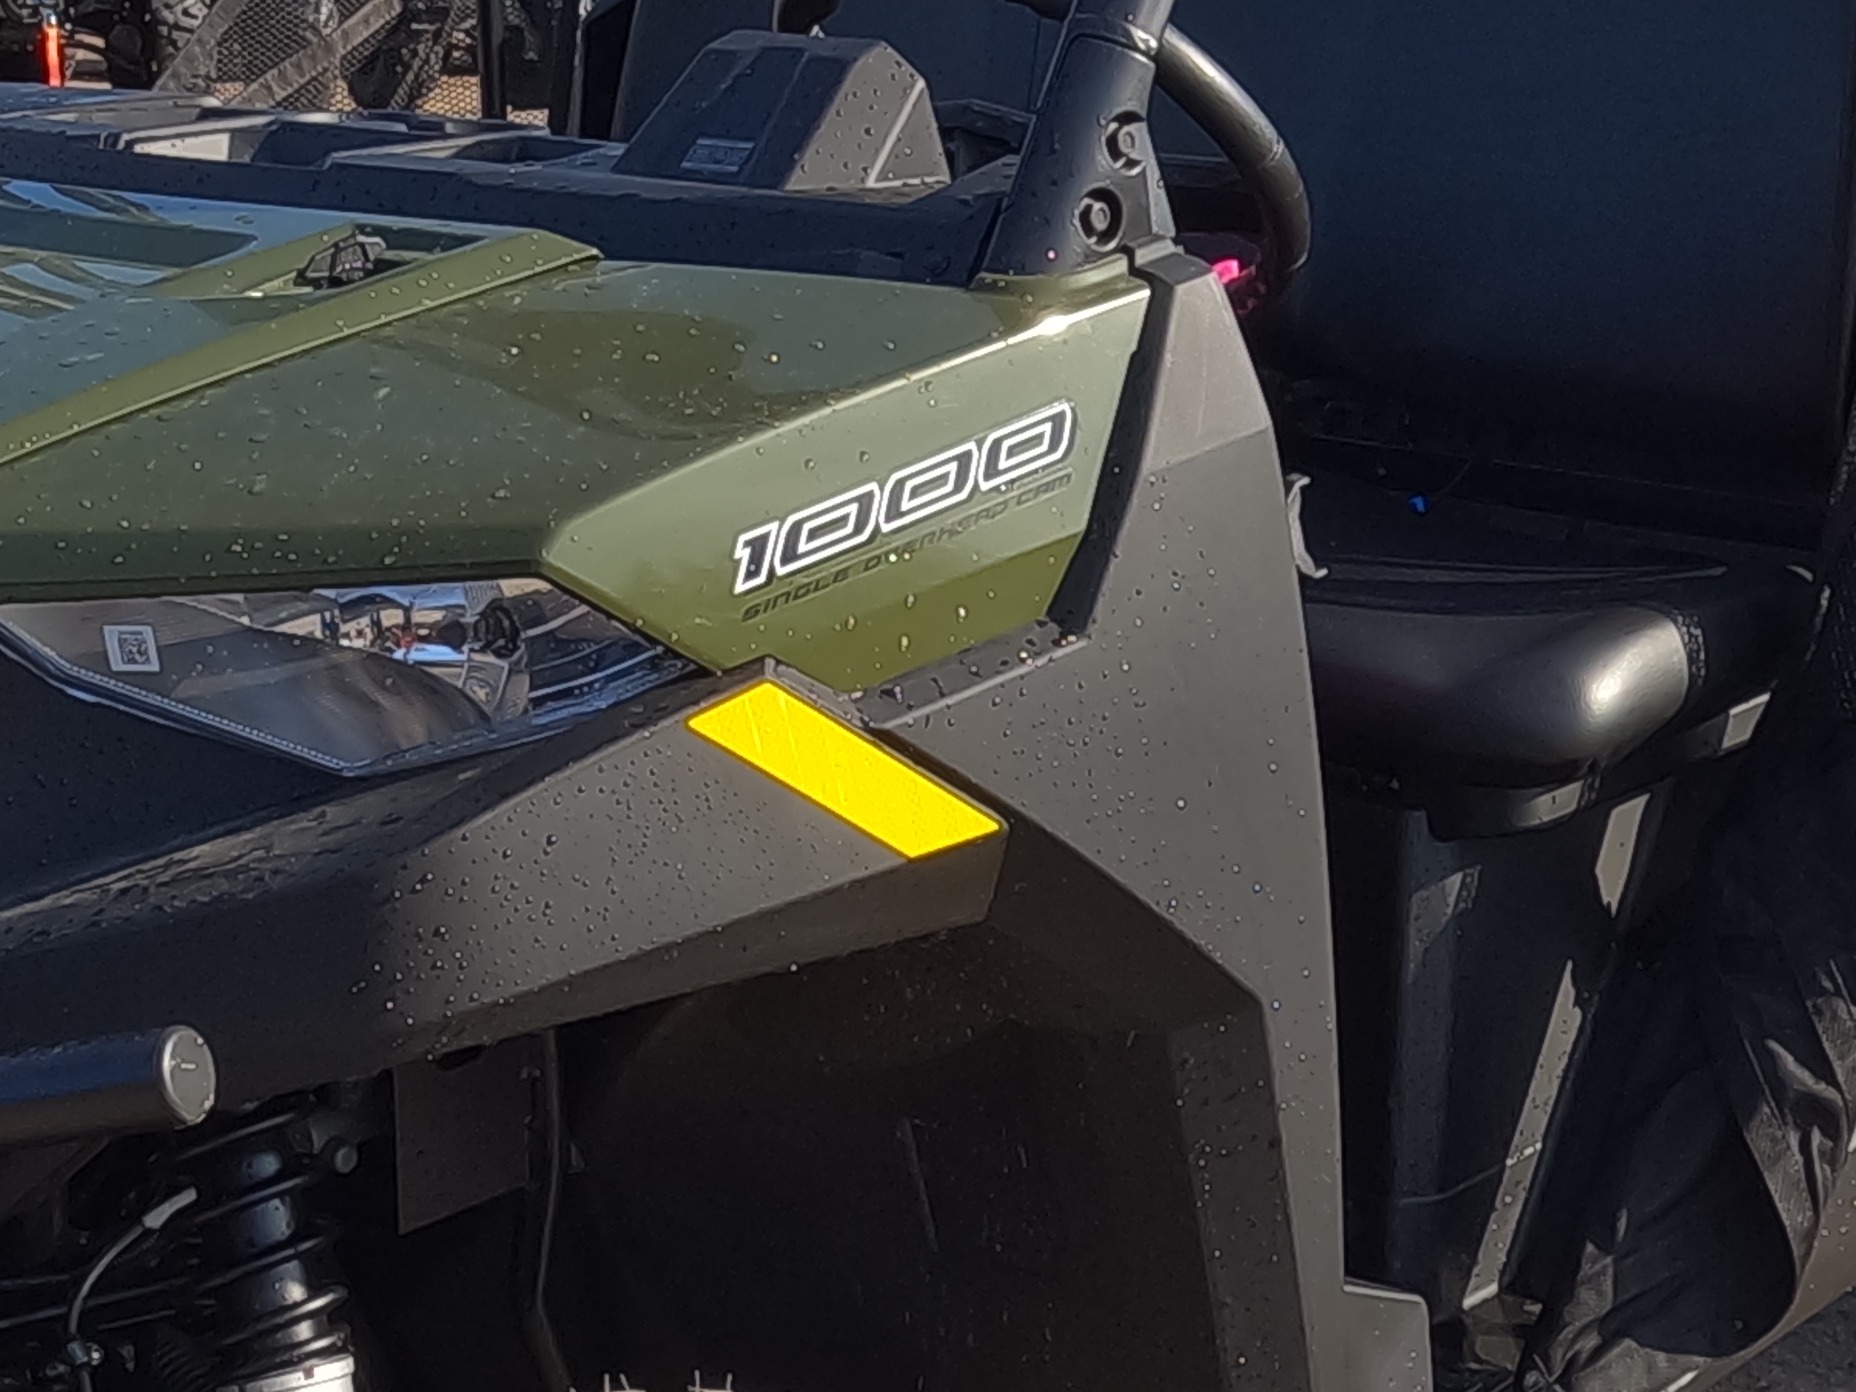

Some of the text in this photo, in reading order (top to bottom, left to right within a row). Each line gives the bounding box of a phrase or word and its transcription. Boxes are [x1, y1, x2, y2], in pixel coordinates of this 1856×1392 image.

[732, 398, 1072, 595] 1000
[742, 566, 850, 624] SINGLE
[1015, 471, 1073, 509] CAM
